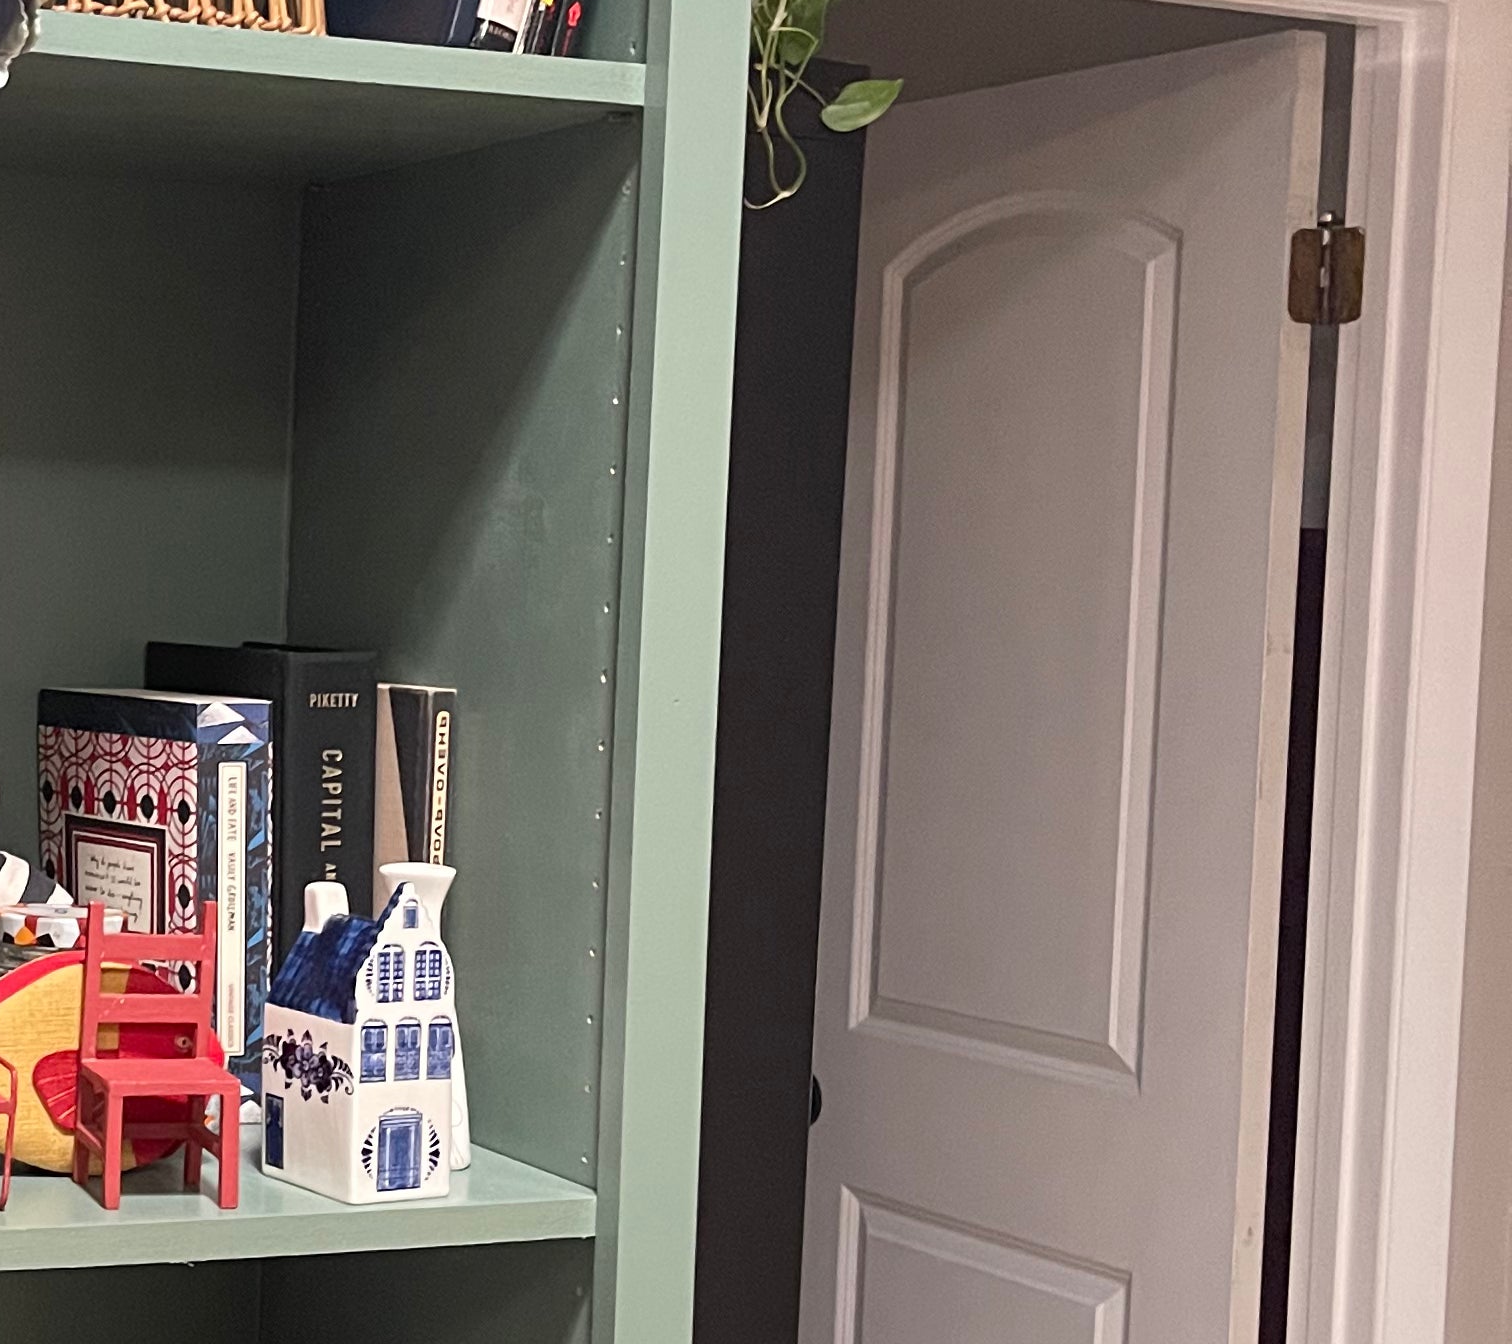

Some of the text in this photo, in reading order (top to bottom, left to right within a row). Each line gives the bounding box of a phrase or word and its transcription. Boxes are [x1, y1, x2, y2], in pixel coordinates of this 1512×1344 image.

[309, 693, 359, 708] PIKETTY
[226, 776, 238, 932] LIFE AND FATE VASILY GROSSMAN
[320, 749, 343, 880] CAPITAL AN
